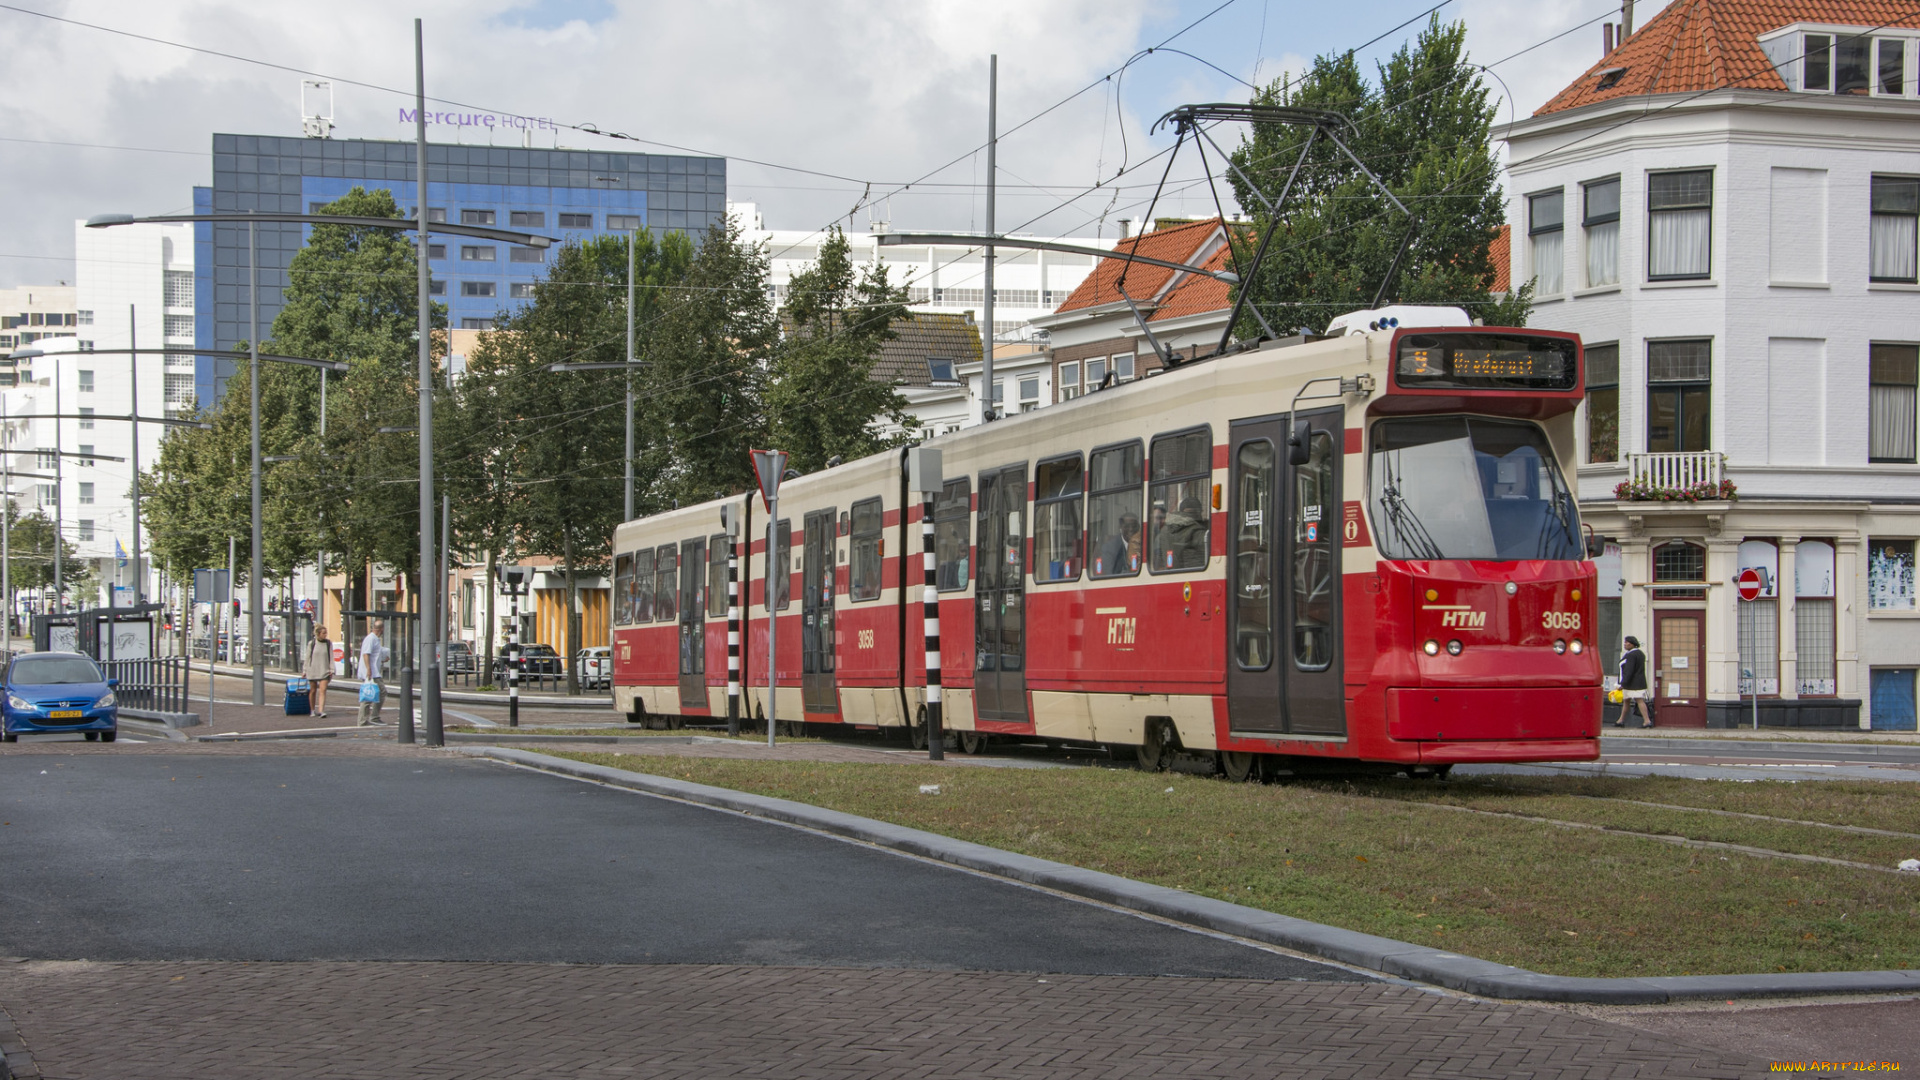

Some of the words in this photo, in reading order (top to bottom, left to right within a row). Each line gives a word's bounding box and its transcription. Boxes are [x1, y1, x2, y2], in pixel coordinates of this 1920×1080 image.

[399, 108, 495, 127] Mercure
[502, 115, 558, 130] HOTEL
[1441, 611, 1487, 627] HTM
[1542, 611, 1581, 629] 3058
[858, 629, 875, 649] 3058
[1107, 617, 1136, 645] HTM
